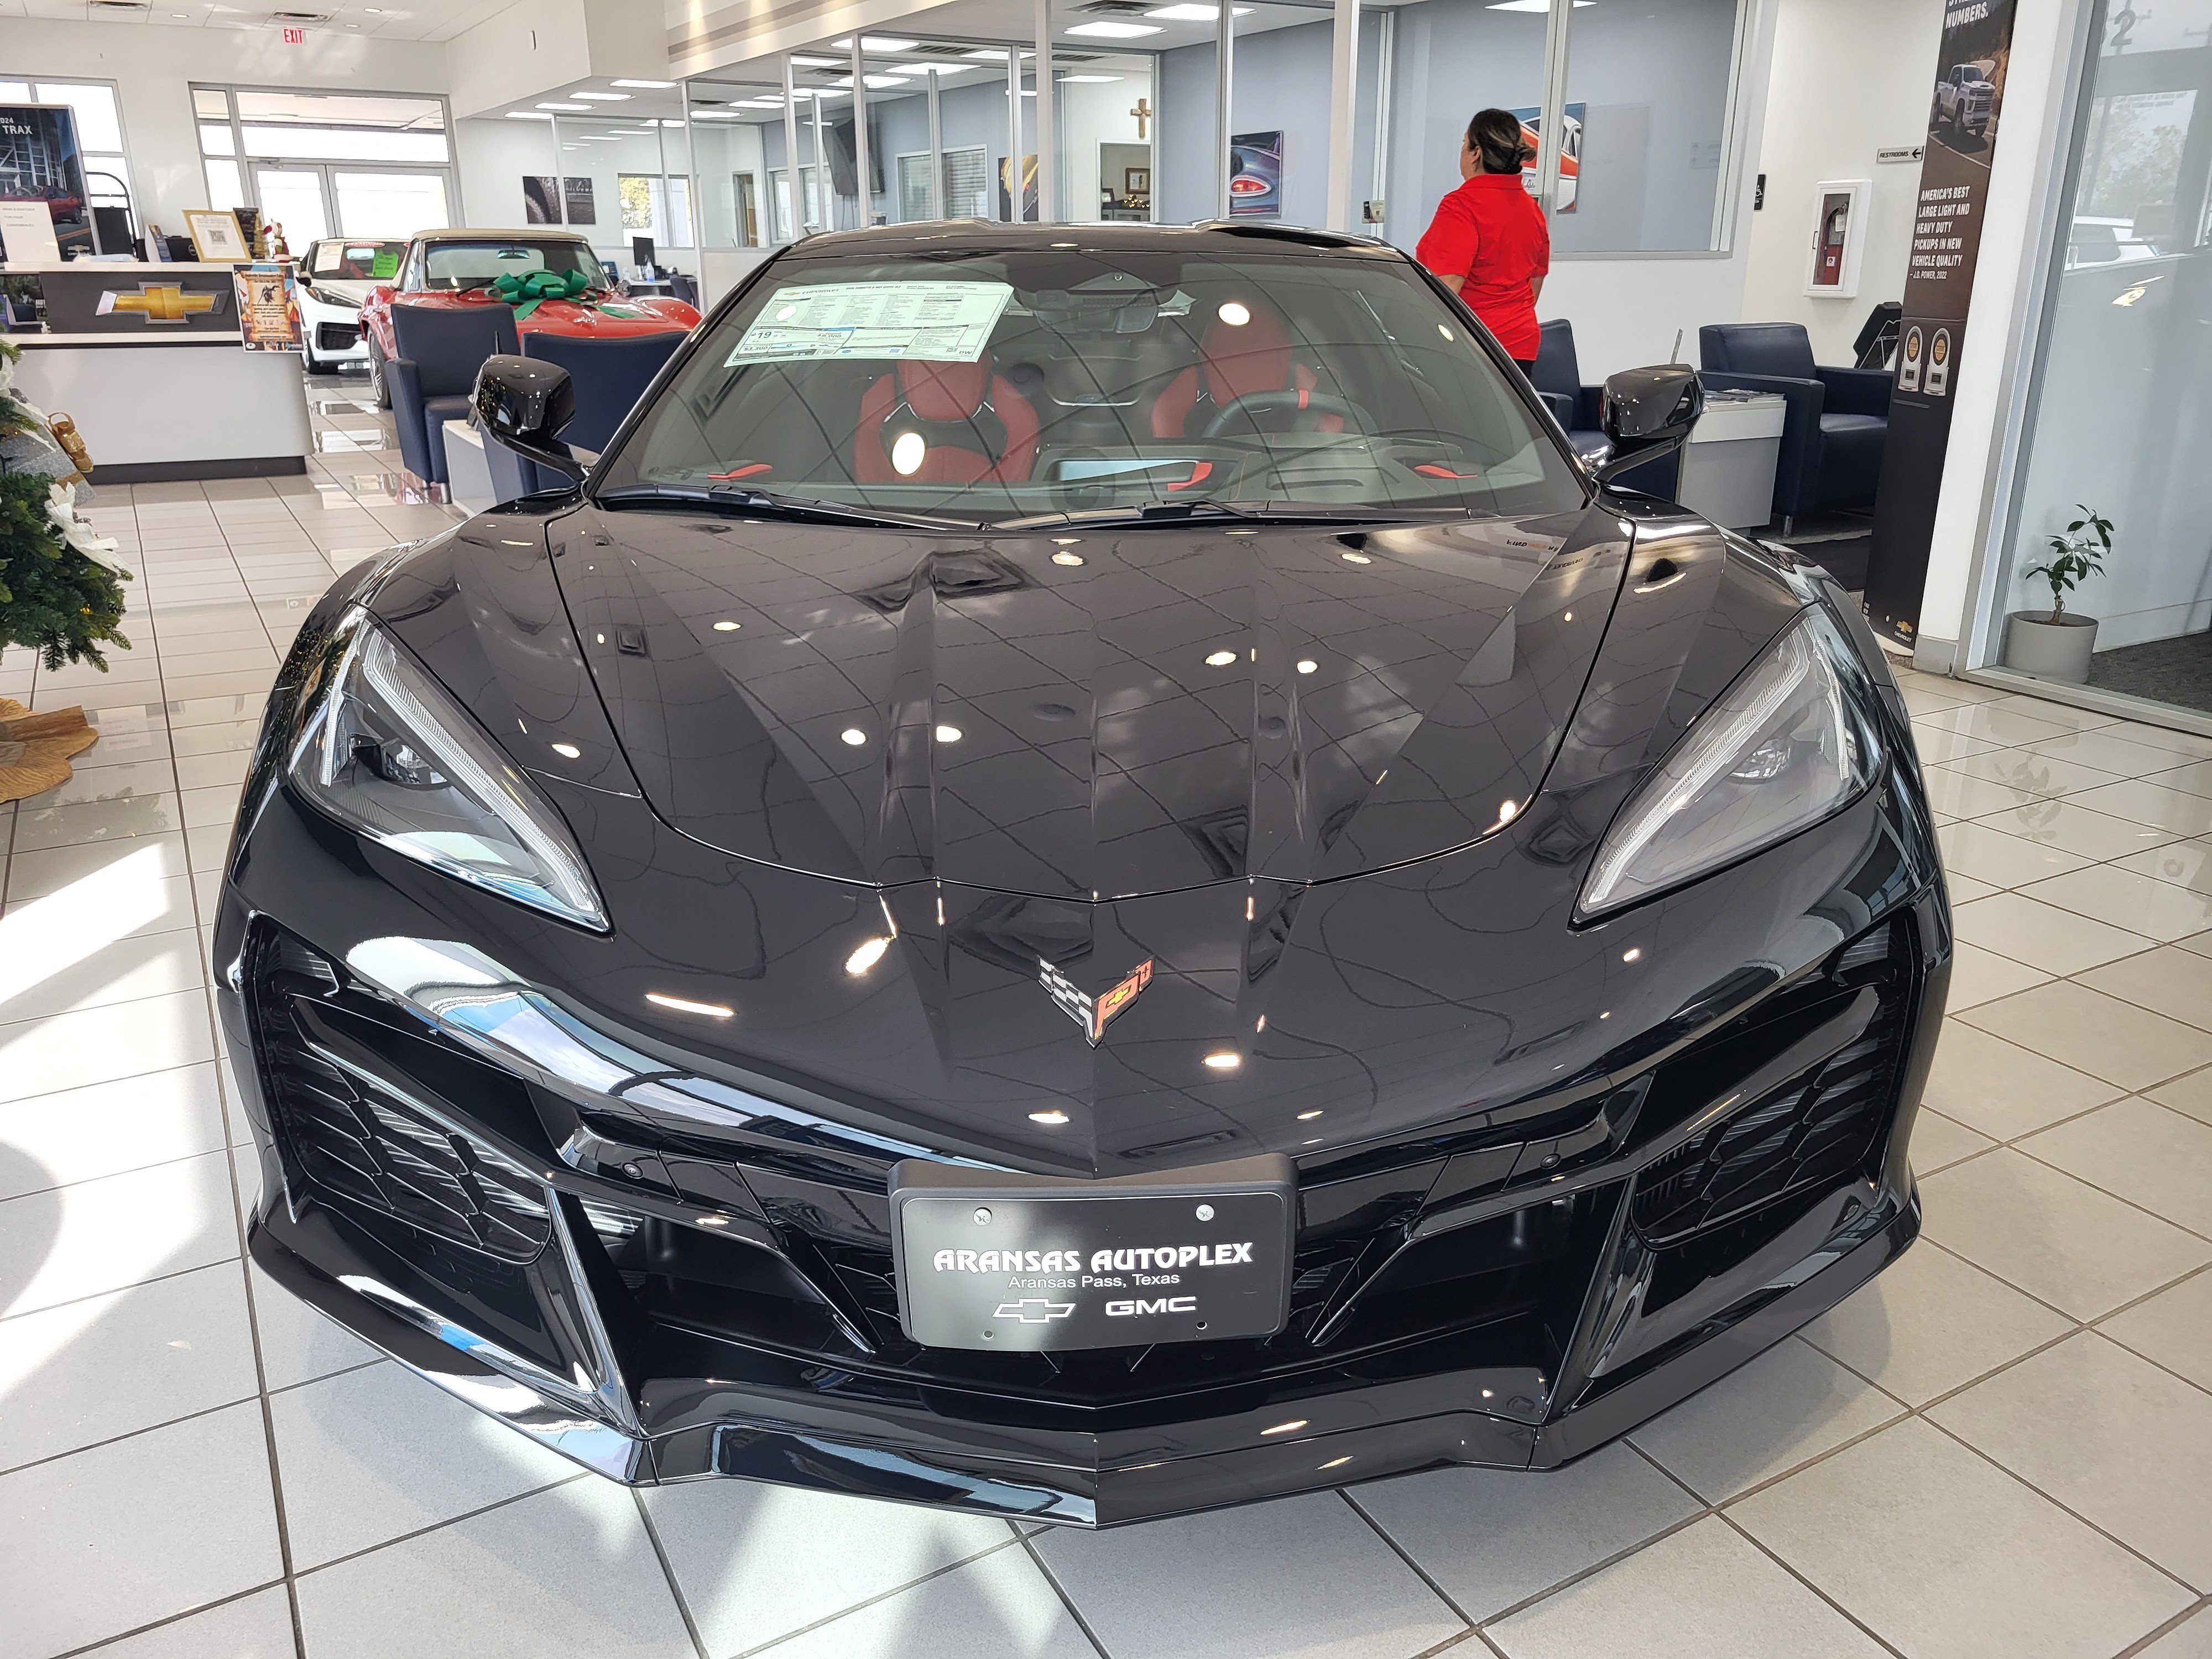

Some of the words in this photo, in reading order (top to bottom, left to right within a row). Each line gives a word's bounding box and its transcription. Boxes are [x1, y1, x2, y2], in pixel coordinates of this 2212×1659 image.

[1945, 1, 1989, 29] NUMBERS.
[284, 29, 302, 43] EXIT
[2, 125, 33, 134] TRAX
[1920, 187, 1953, 202] AMERICA'S
[1953, 186, 1970, 199] BEST
[1918, 205, 1938, 218] LARGE
[1937, 204, 1957, 217] LIGHT
[1955, 203, 1970, 216] AND
[1916, 222, 1936, 234] HEAVY
[1936, 221, 1953, 233] DUTY
[1913, 238, 1939, 251] PICKUPS
[1938, 238, 1947, 250] IN
[1947, 237, 1963, 250] NEW
[1912, 255, 1936, 267] VEHICLE
[1936, 254, 1963, 267] QUALITY
[1936, 270, 1948, 279] 2022
[933, 1248, 1082, 1274] ARANSAS
[1090, 1242, 1253, 1274] AUTOPLEX
[1007, 1275, 1077, 1288] Aransas
[1082, 1275, 1126, 1288] Pass,
[1131, 1273, 1180, 1286] Texas
[1105, 1296, 1197, 1317] GMC
